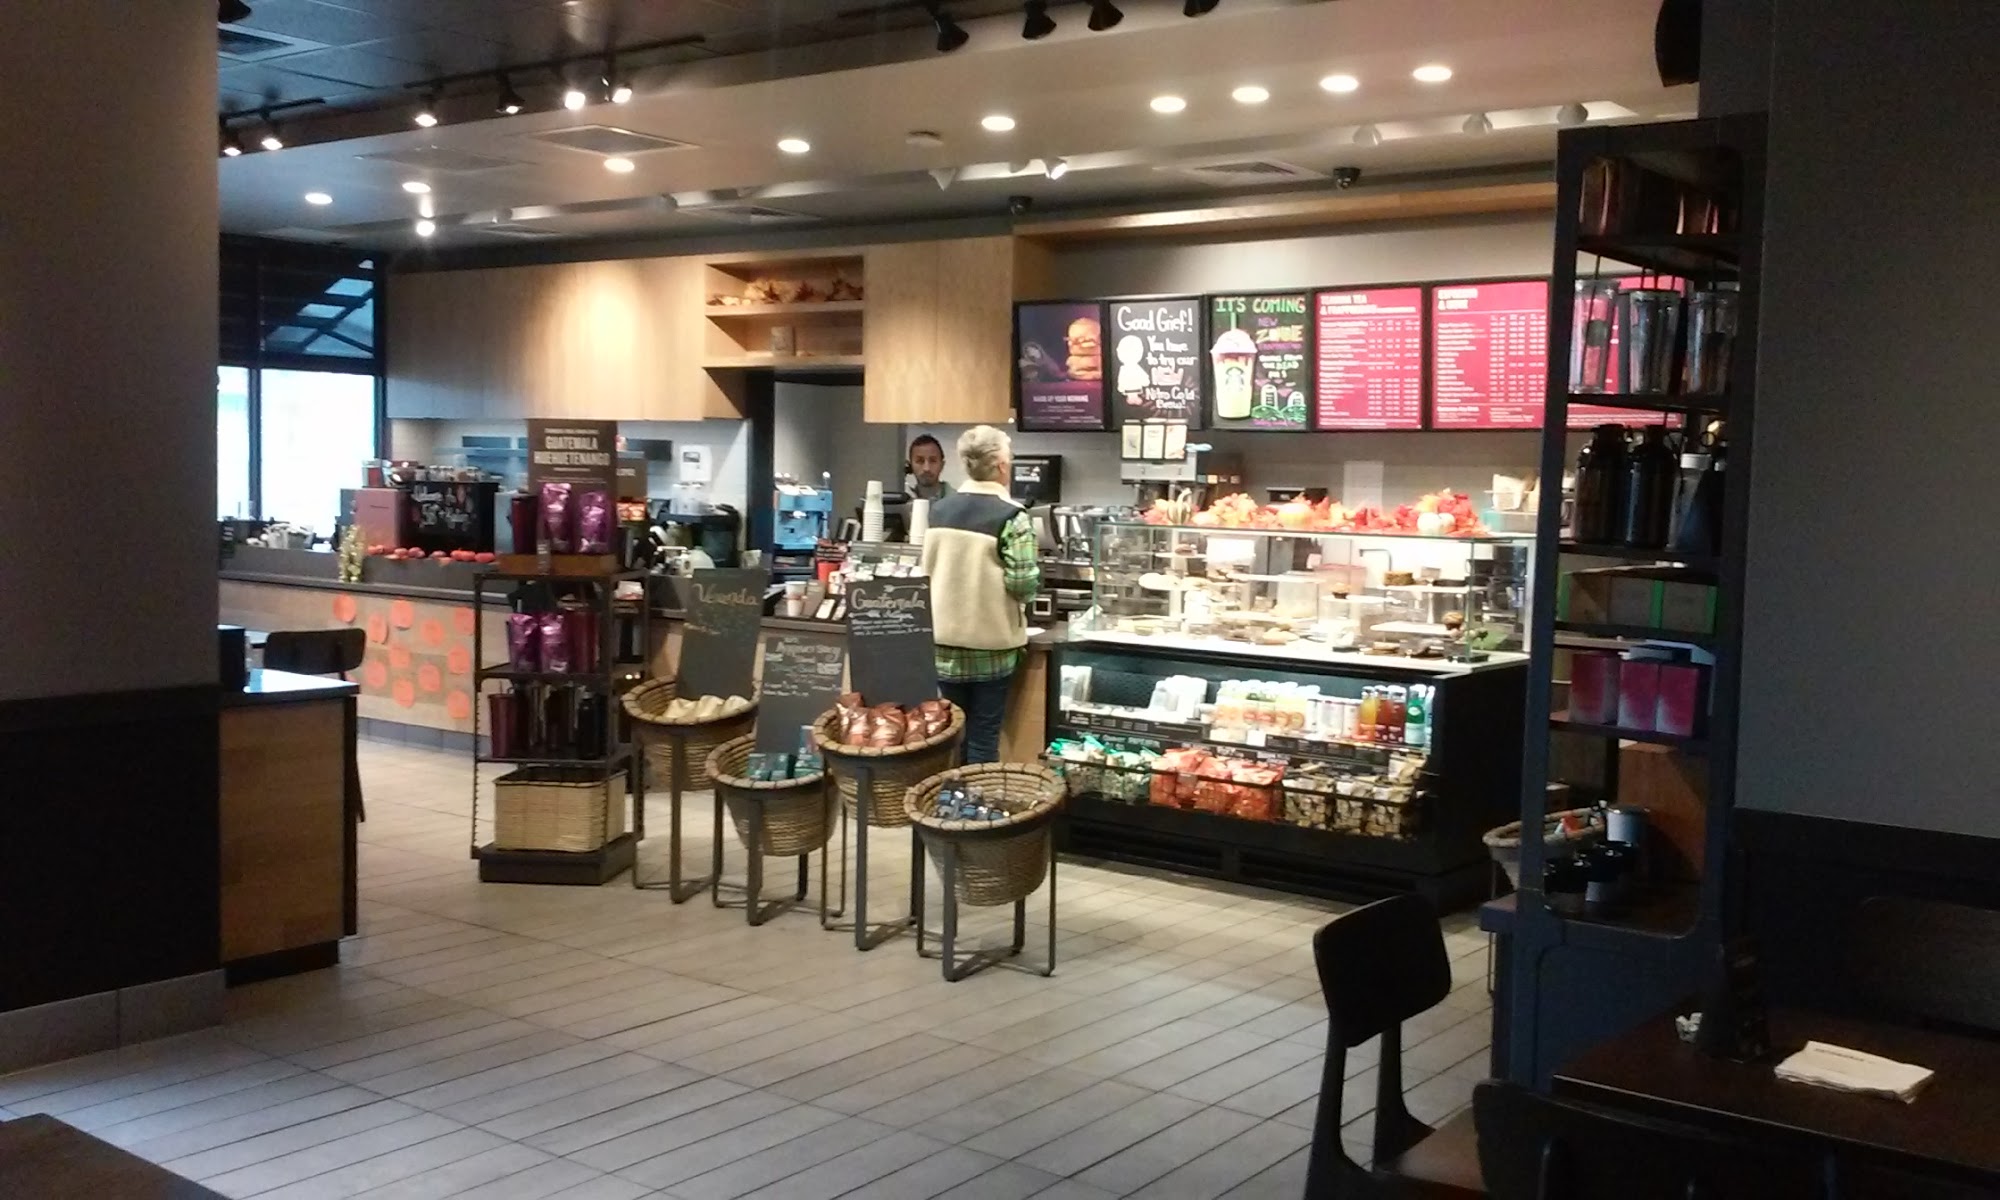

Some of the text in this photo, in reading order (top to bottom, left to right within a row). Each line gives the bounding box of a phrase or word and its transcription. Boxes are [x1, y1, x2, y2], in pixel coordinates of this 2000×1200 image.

[1216, 296, 1306, 313] IT'S COMING
[1117, 306, 1193, 332] Good Grief!
[1147, 335, 1165, 352] You
[1176, 356, 1198, 366] our
[1145, 386, 1195, 401] Nitro Cold
[545, 436, 599, 450] GUATEMALA
[534, 451, 611, 466] HUEHUETENANGO
[851, 588, 927, 611] Guatemala
